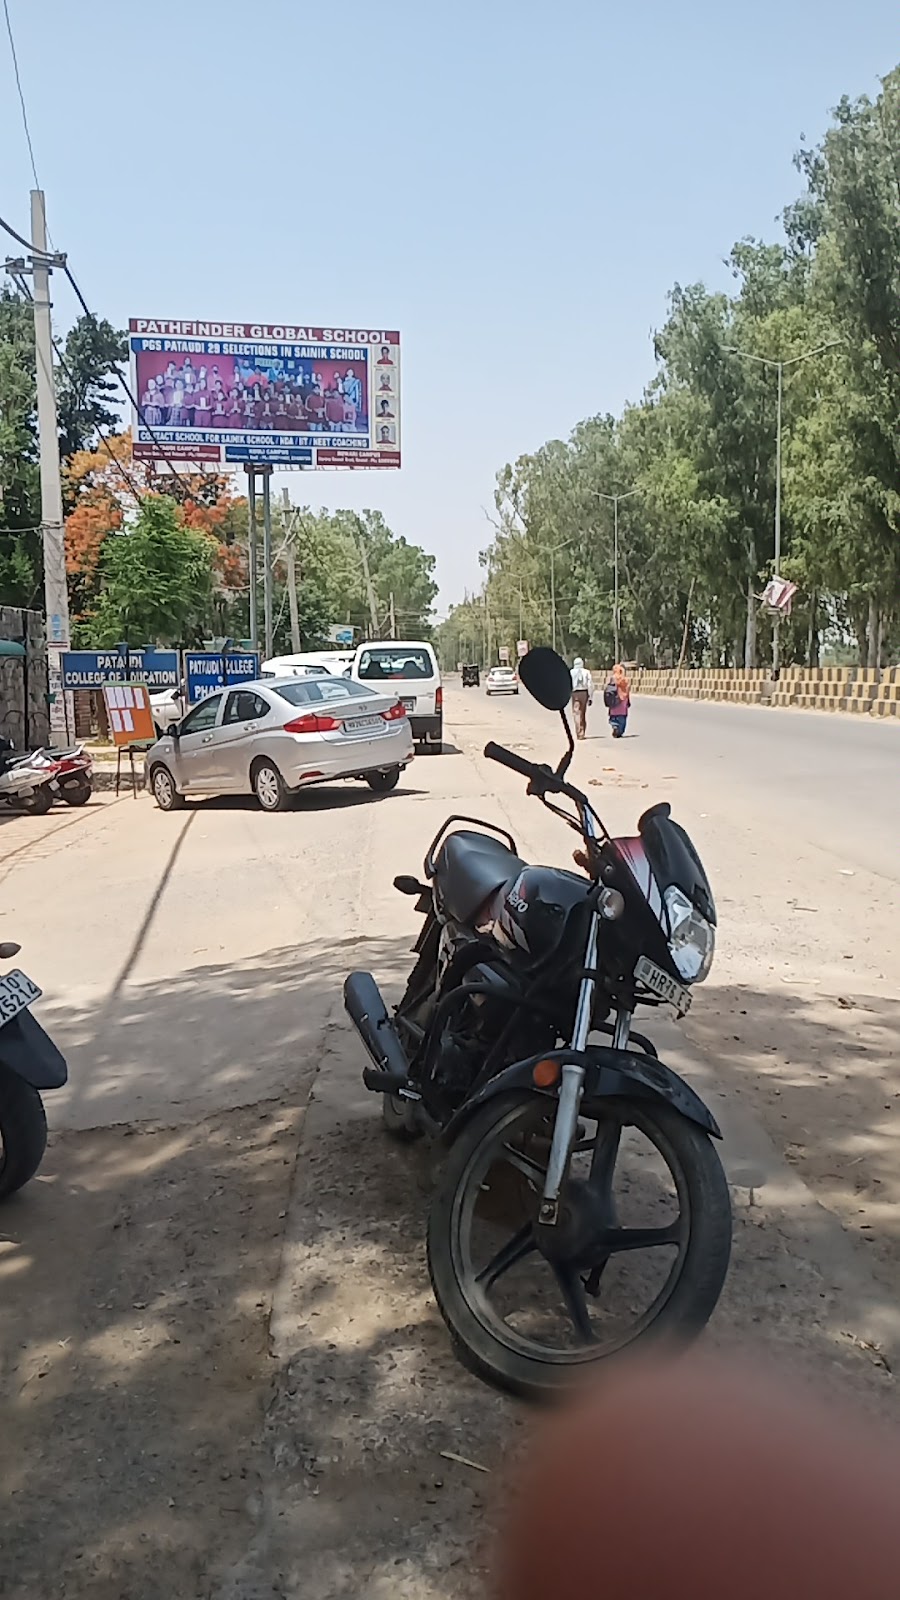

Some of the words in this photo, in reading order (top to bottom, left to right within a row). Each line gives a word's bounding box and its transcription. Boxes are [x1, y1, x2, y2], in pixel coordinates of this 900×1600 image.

[137, 320, 245, 337] PATHFINDER
[250, 325, 318, 340] GLOBAL
[322, 329, 391, 344] SCHOOL
[142, 340, 162, 350] PGS
[164, 340, 205, 353] PATAUDI
[223, 343, 278, 357] SELECTIONS
[281, 346, 292, 357] IN
[294, 347, 327, 359] SAINIK
[330, 348, 366, 360] SCHOOL
[175, 432, 204, 442] SCHOOL
[205, 433, 220, 443] FOR
[247, 435, 274, 445] SCHOOL
[313, 437, 331, 447] NEET
[332, 438, 367, 448] COACHING
[97, 655, 143, 669] PATAUDI
[65, 671, 106, 684] COLLEGE
